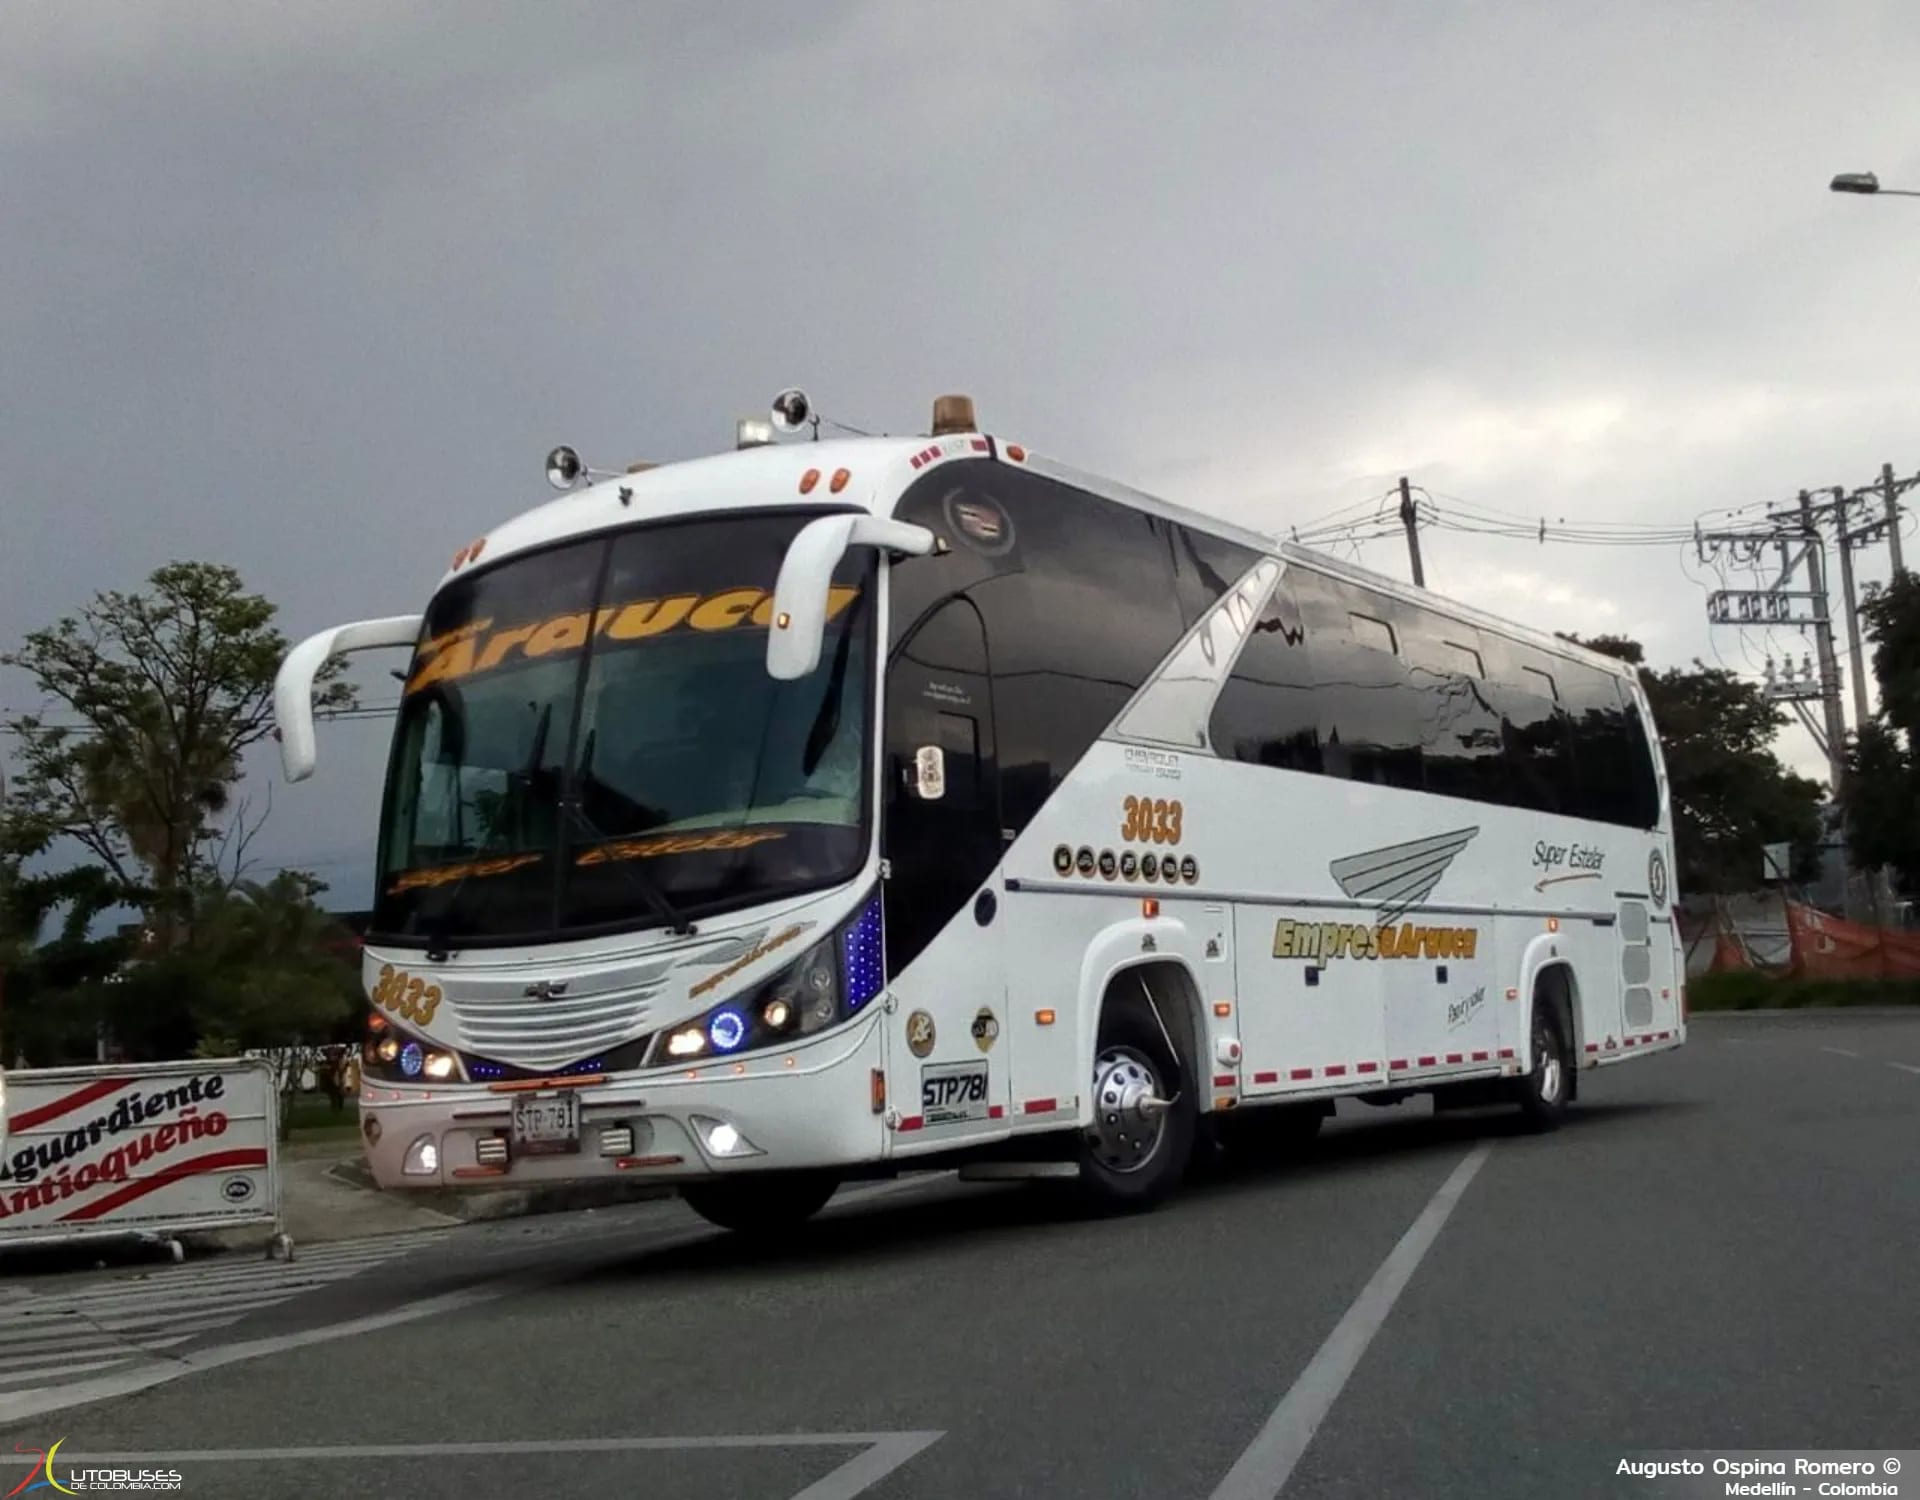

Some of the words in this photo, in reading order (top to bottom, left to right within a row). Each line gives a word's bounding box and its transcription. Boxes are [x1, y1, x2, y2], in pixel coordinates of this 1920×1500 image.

[1121, 794, 1183, 846] 3033
[1533, 840, 1567, 872] Super
[1568, 843, 1605, 870] Estelar
[371, 963, 442, 1027] 3033
[922, 1072, 988, 1106] STP781
